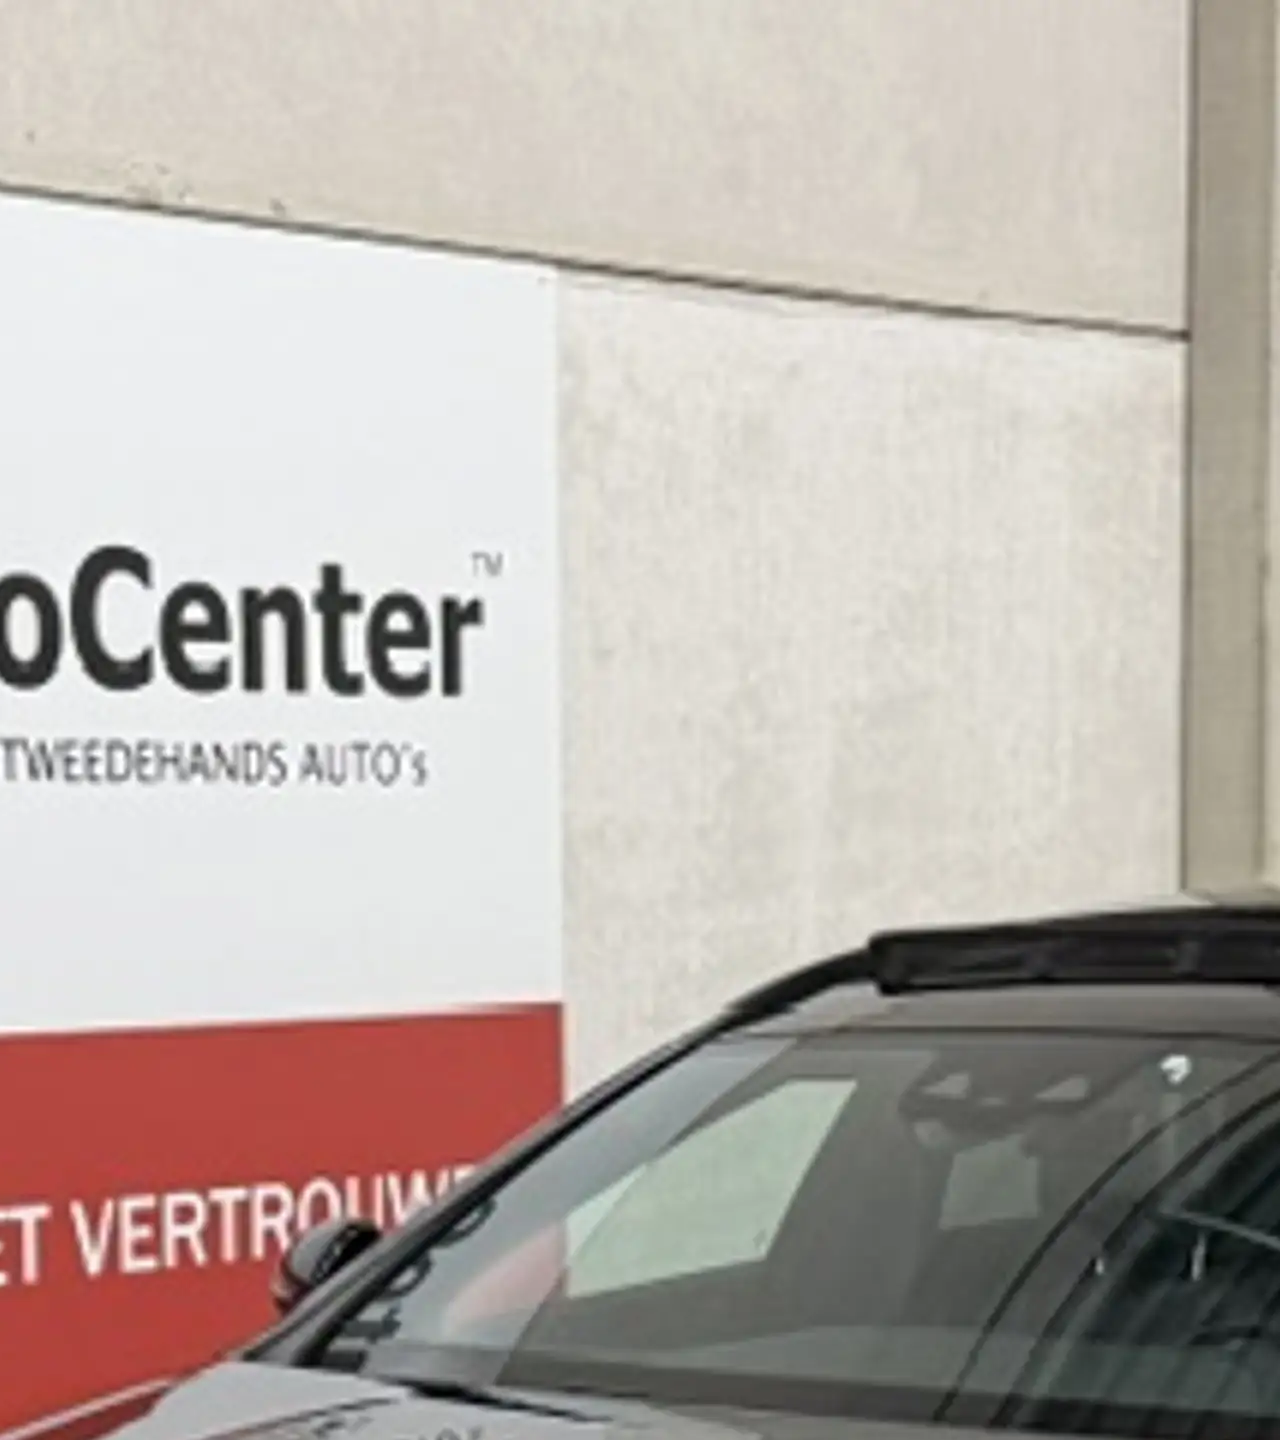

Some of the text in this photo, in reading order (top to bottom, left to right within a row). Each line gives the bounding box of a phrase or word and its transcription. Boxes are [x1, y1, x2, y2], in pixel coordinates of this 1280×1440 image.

[0, 738, 289, 787] TWEEDEHANDS
[300, 740, 428, 788] AUTO's
[69, 1163, 477, 1278] VERTROUW
